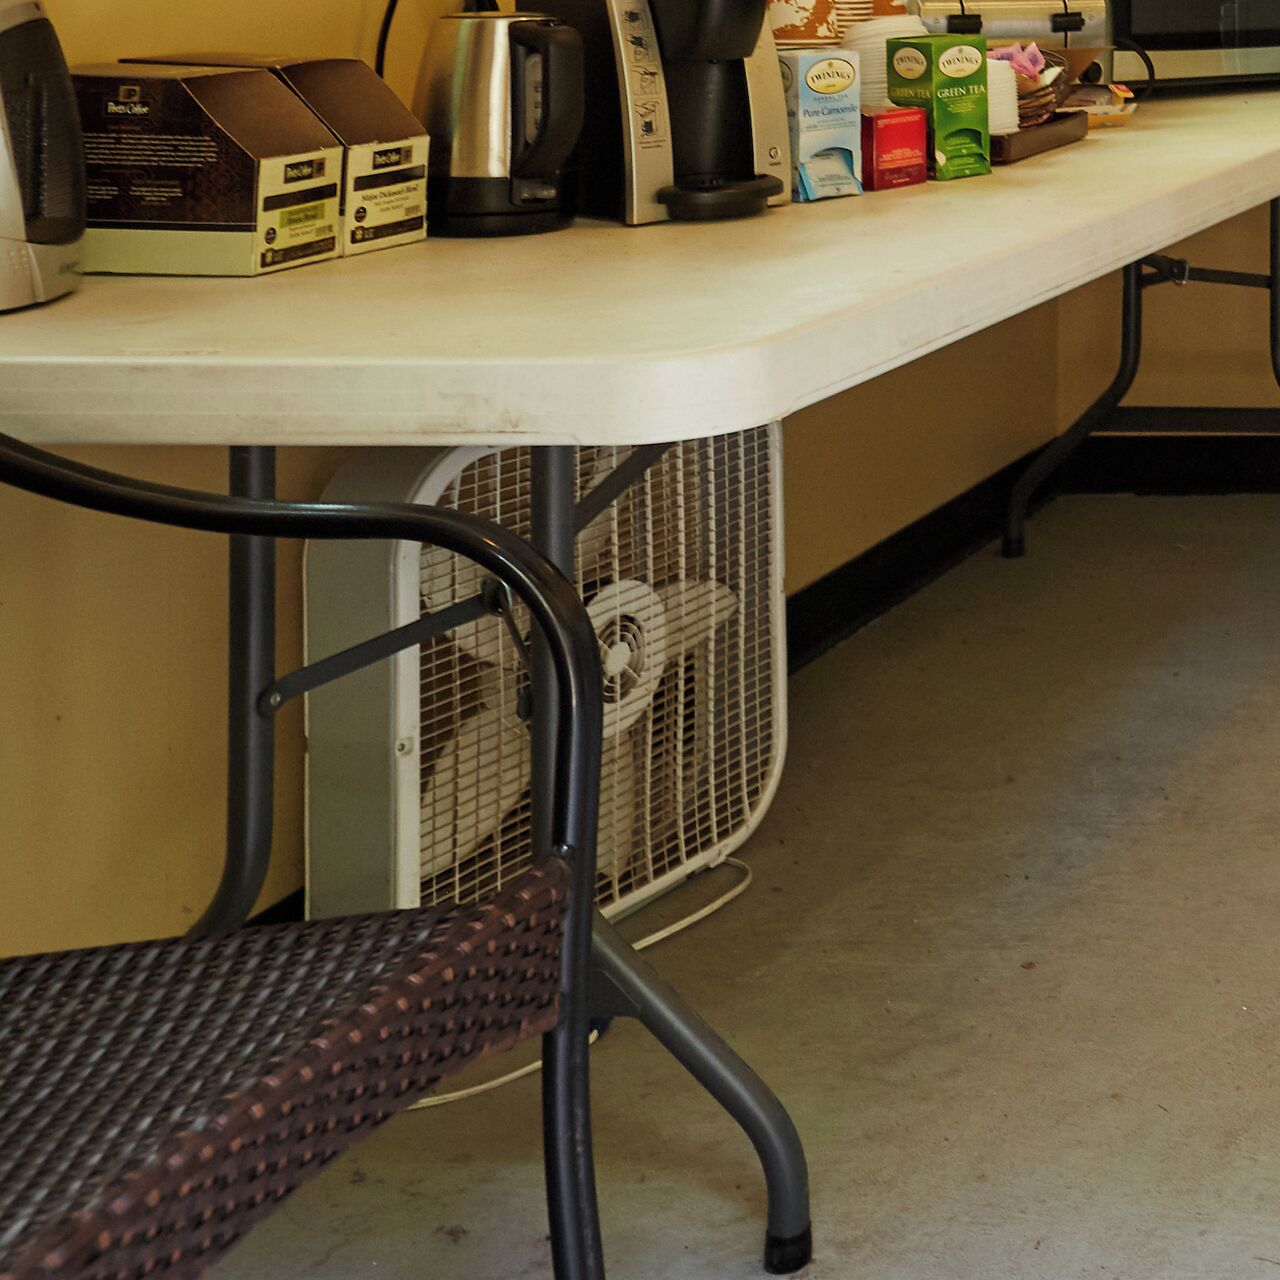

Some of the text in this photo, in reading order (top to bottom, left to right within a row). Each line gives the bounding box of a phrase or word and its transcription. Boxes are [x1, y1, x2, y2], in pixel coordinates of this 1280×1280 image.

[942, 56, 980, 68] TWININGS
[810, 71, 851, 84] TWININGS
[916, 88, 931, 98] TEA
[937, 84, 986, 99] GREEN TEA
[803, 104, 858, 119] Pure Camomile
